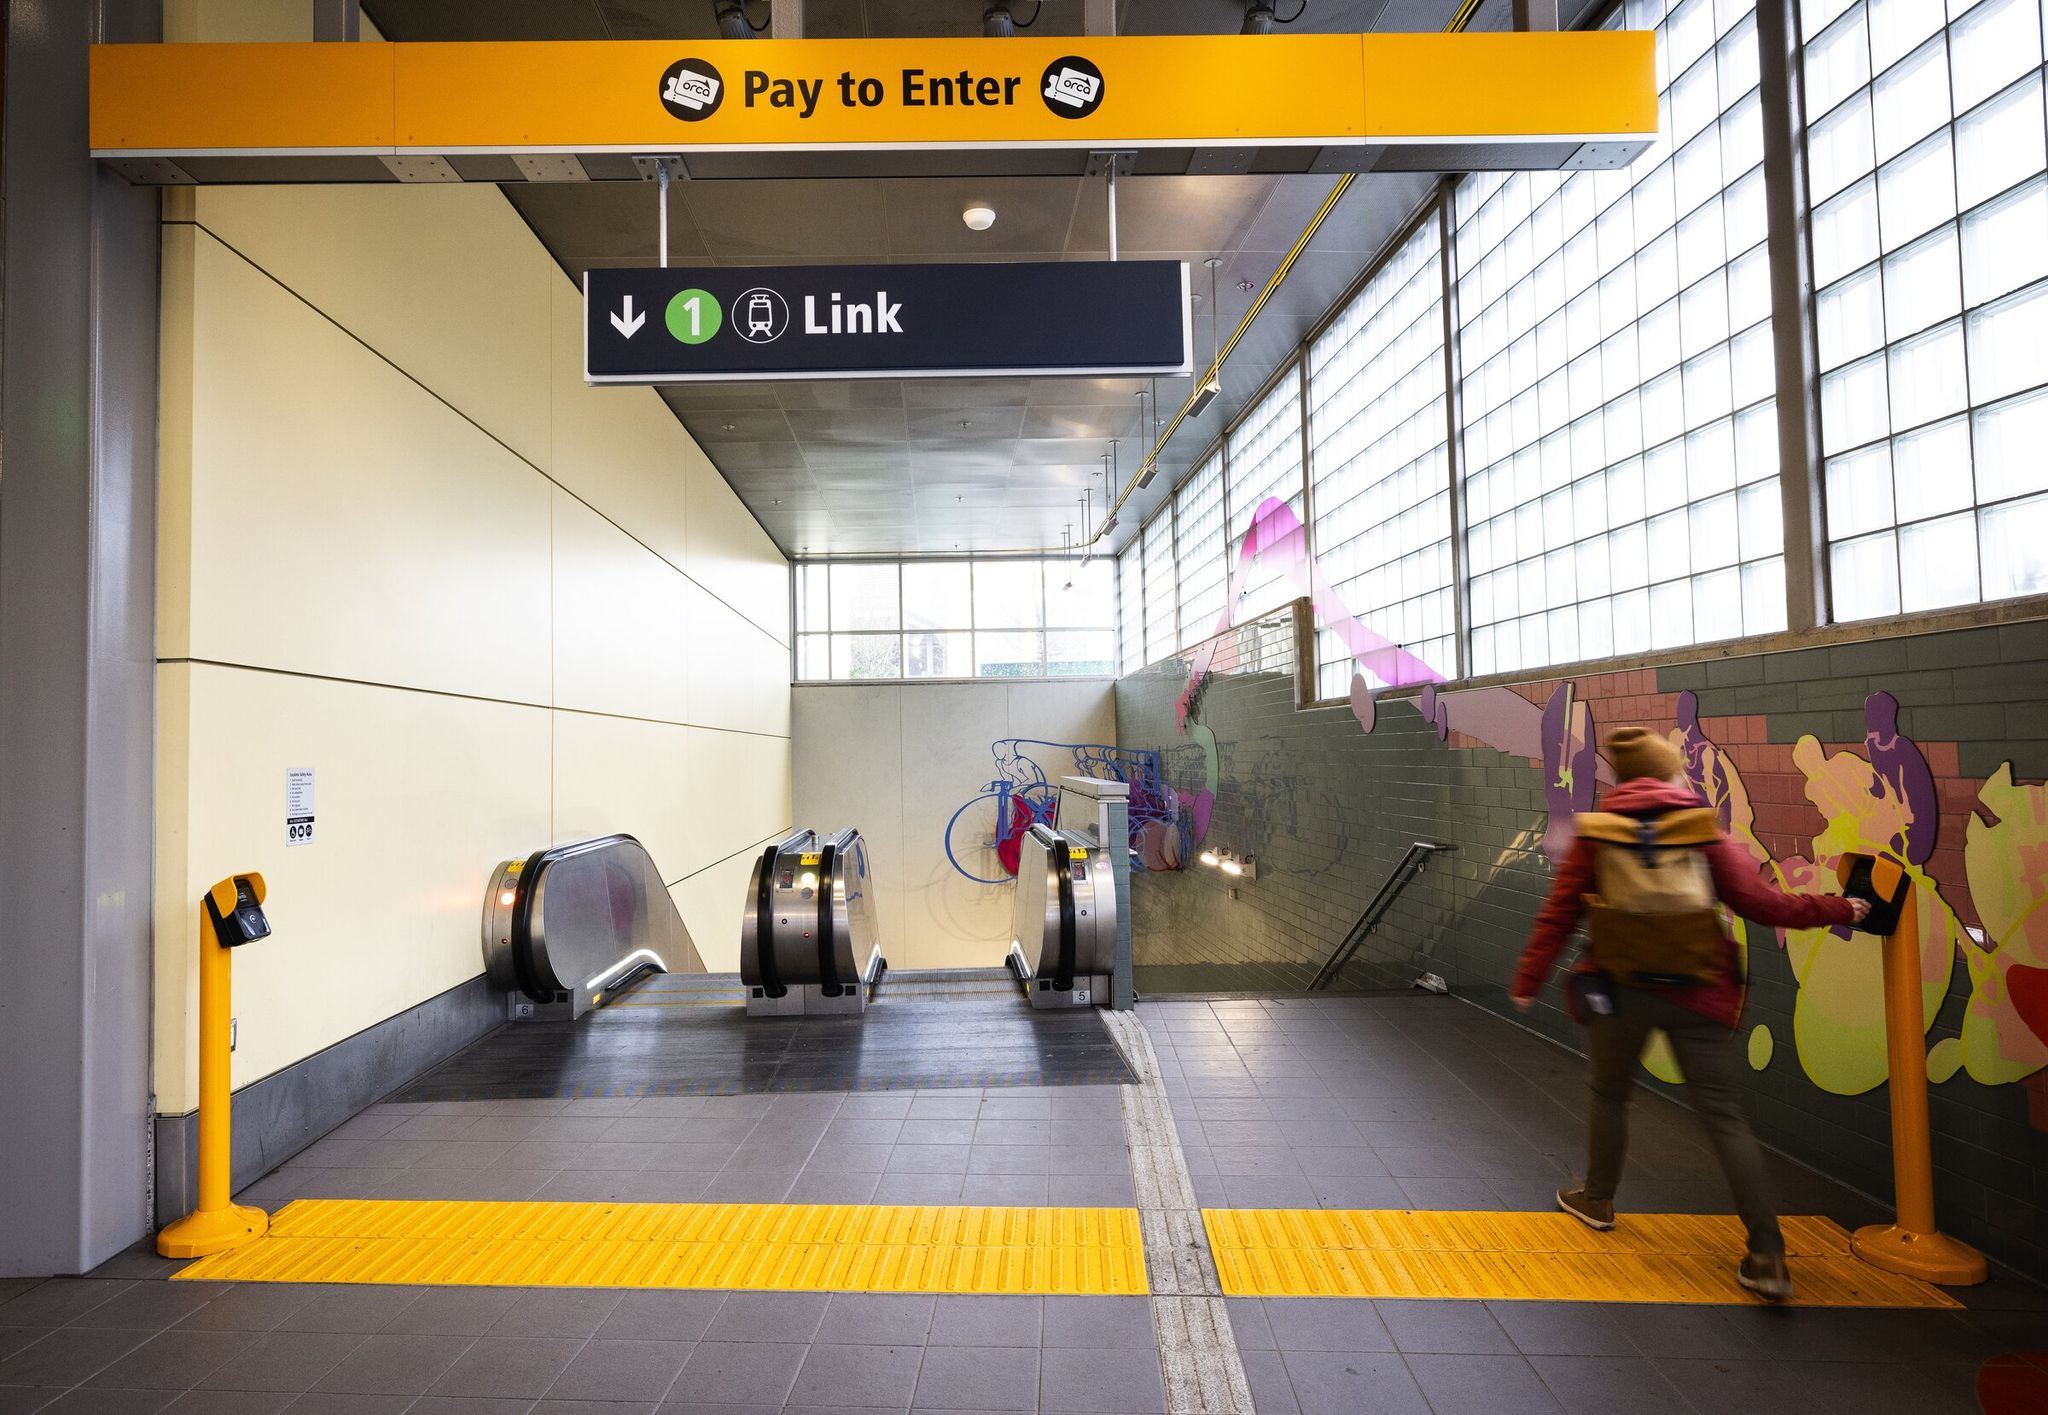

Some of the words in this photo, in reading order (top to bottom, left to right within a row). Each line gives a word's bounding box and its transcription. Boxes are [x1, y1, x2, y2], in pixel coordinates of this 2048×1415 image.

[683, 82, 710, 98] orca
[745, 71, 824, 118] Pay
[837, 72, 883, 107] to
[903, 69, 1021, 106] Enter
[1063, 80, 1091, 95] orca
[683, 297, 700, 336] 1
[805, 292, 904, 334] Link
[1078, 991, 1086, 1001] 5
[521, 1005, 529, 1015] 6
